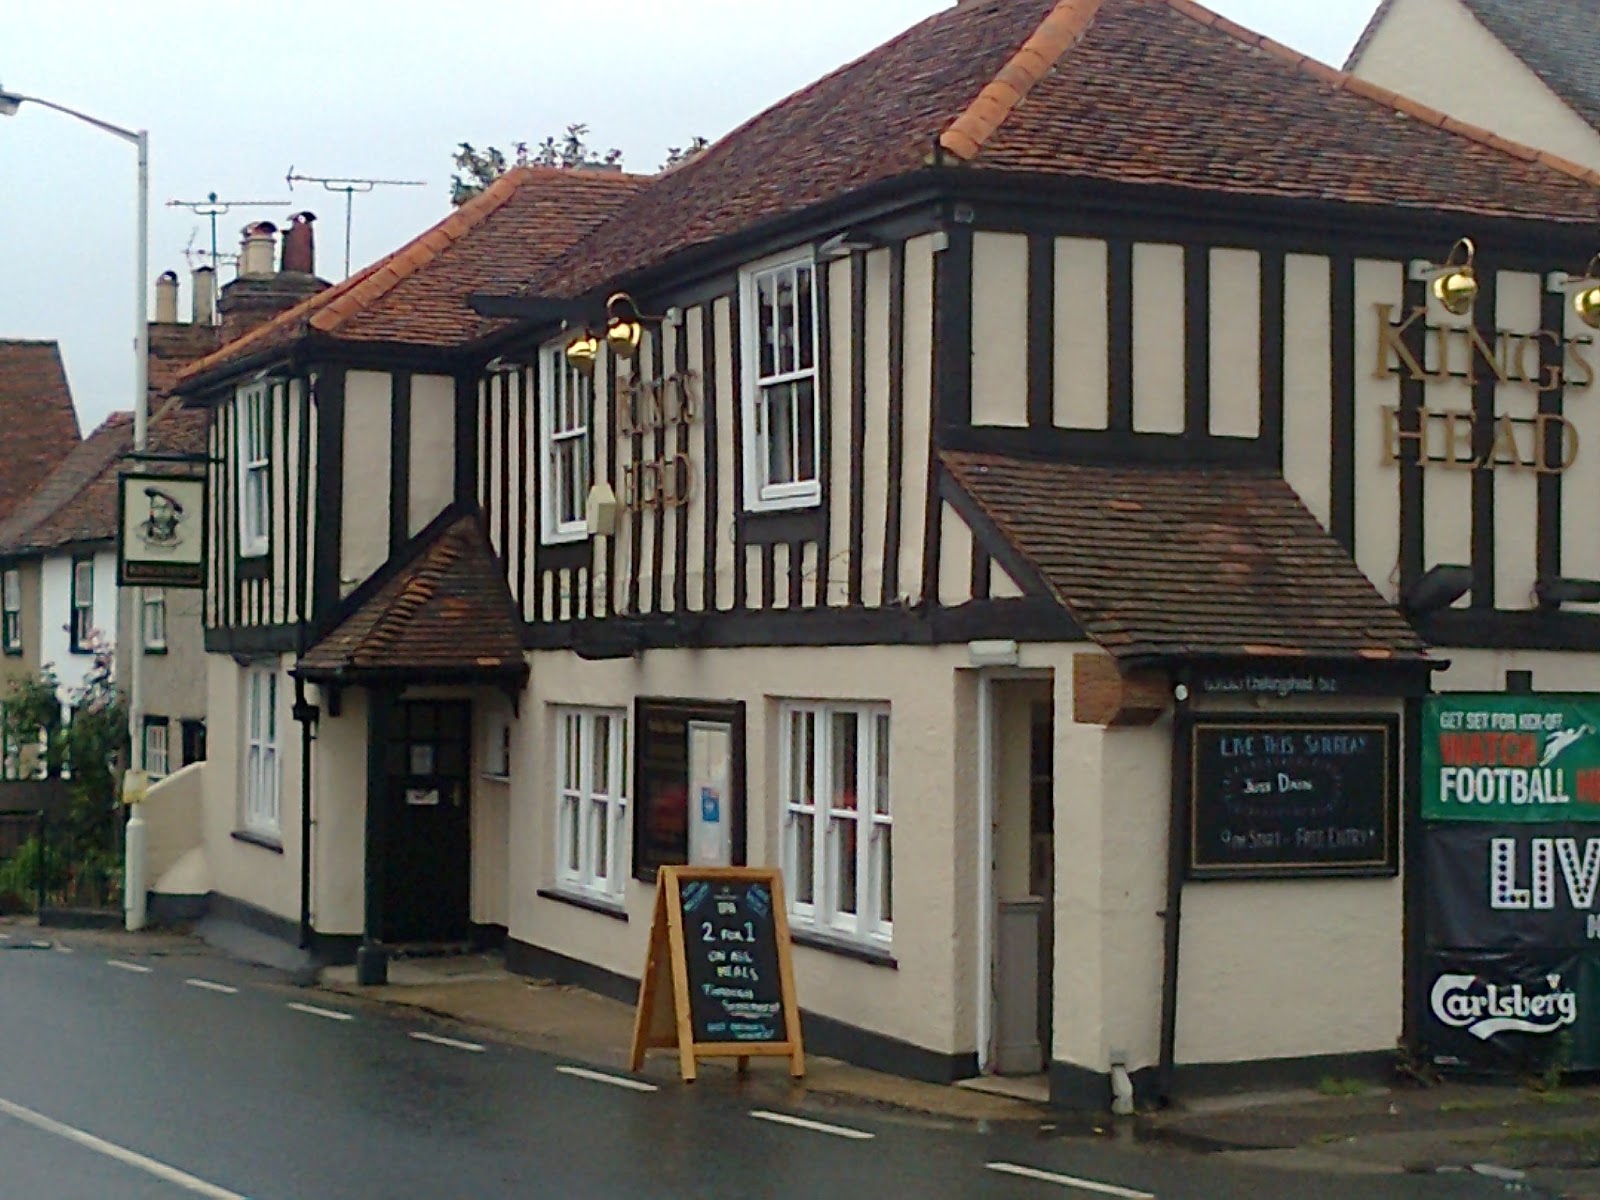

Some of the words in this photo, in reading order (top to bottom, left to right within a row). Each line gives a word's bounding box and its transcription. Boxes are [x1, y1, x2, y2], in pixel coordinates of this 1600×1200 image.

[1373, 303, 1594, 391] KINGS
[1379, 404, 1580, 474] HEAD
[1440, 732, 1538, 767] WATCH
[1439, 767, 1571, 805] FOOTBALL
[702, 922, 716, 941] 2
[744, 921, 756, 943] 1
[717, 966, 758, 980] MEALS
[1431, 973, 1578, 1032] Carlsberg
